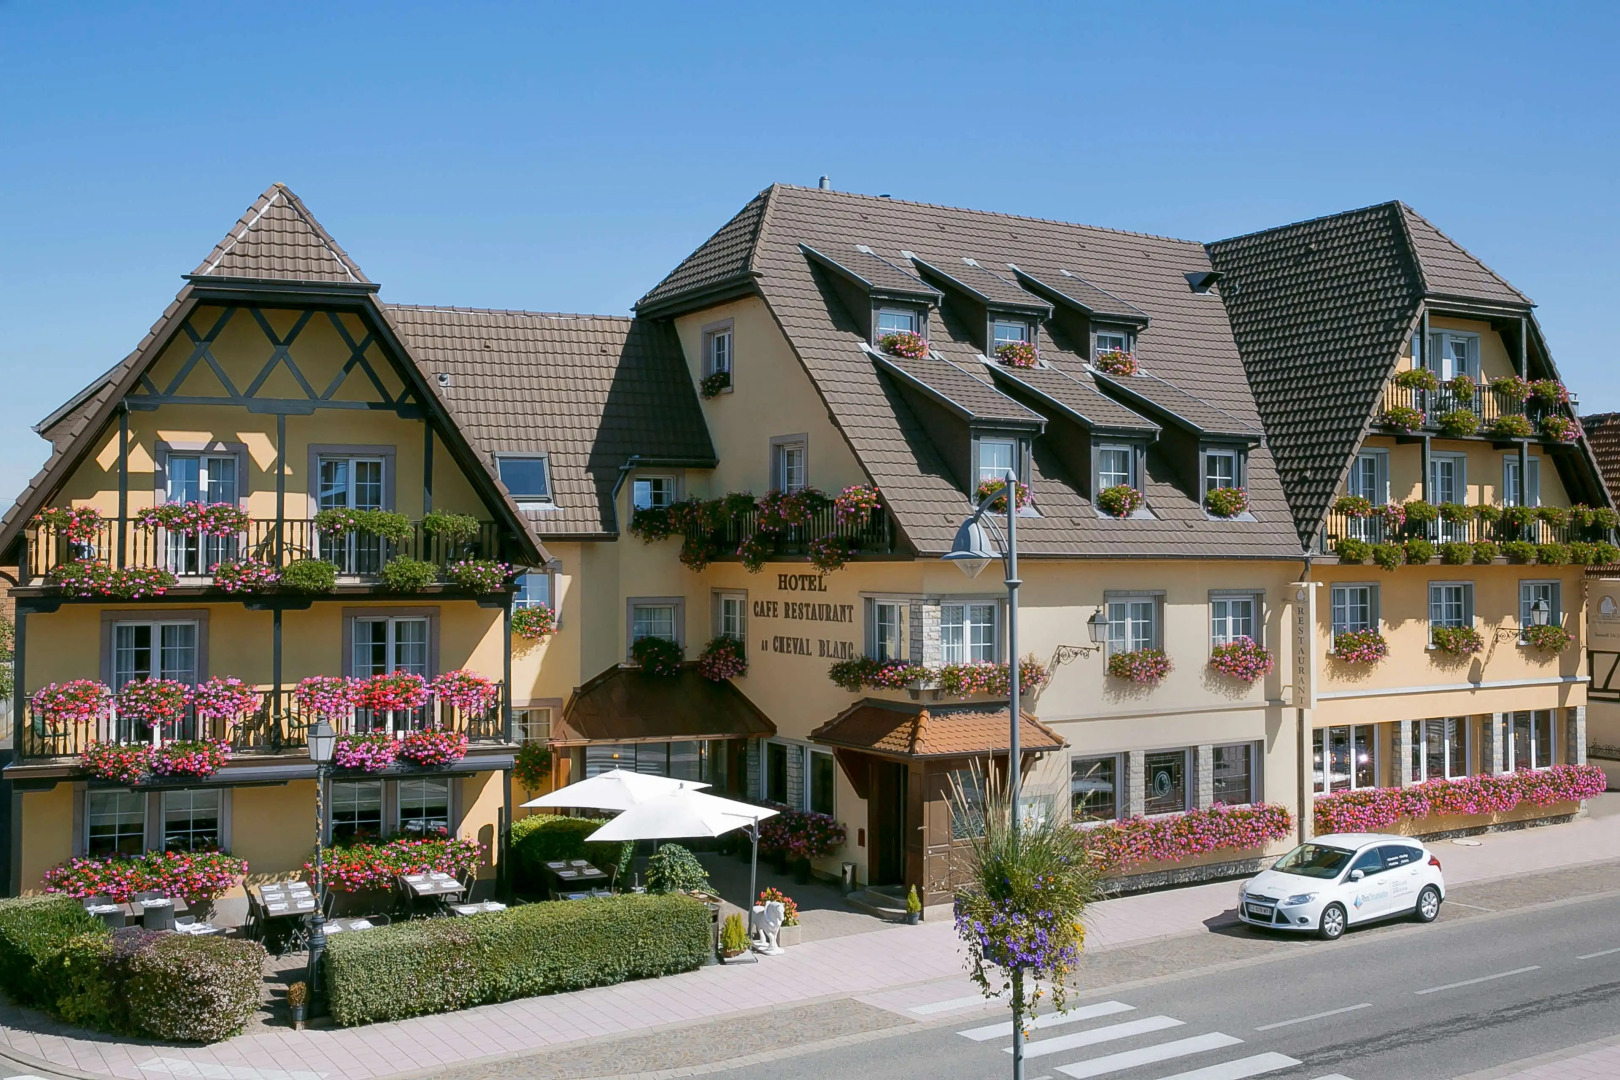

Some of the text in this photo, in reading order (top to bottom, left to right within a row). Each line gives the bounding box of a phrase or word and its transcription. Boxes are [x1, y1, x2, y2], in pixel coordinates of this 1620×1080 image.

[778, 574, 827, 592] HOTEL
[753, 601, 854, 623] CAFE RESTAURANT
[772, 635, 812, 656] CHEVAL
[818, 639, 854, 660] BLANC
[1297, 607, 1305, 704] RESTAURANT
